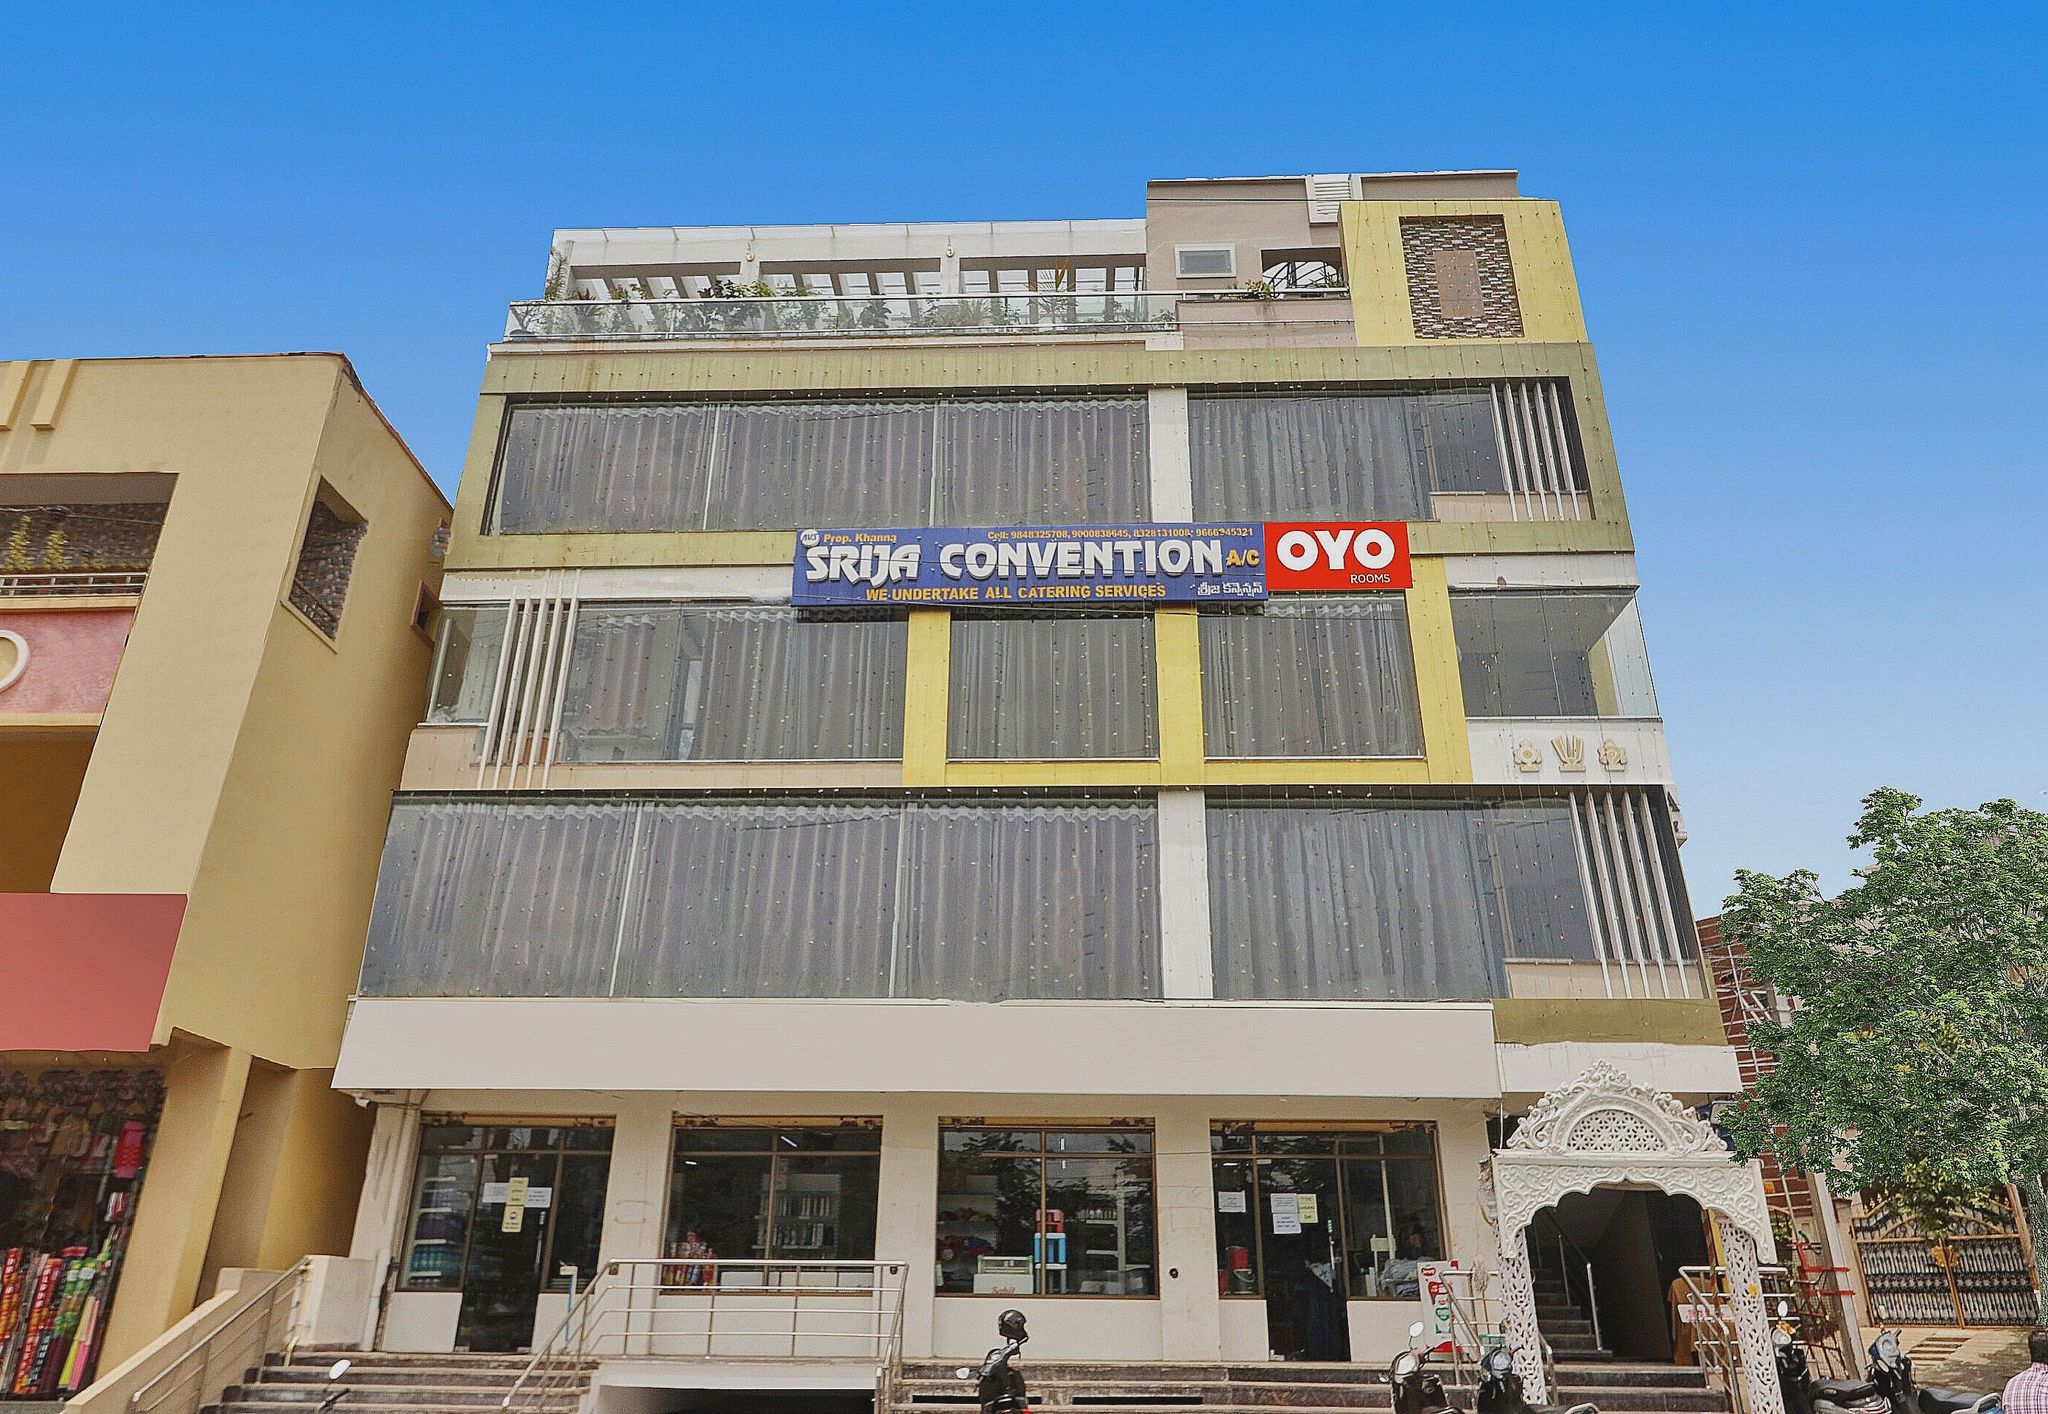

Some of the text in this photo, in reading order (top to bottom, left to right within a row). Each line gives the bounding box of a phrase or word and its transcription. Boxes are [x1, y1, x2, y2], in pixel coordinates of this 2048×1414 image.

[823, 533, 897, 544] Prop. Khanna
[988, 531, 1009, 540] Cell:
[1276, 528, 1395, 572] OYO
[806, 539, 1260, 588] SRIJA CONVENTION A/C
[1350, 573, 1391, 584] ROOMS
[866, 583, 1167, 601] WE UNDERTAKE ALL CATERING SERVICES
